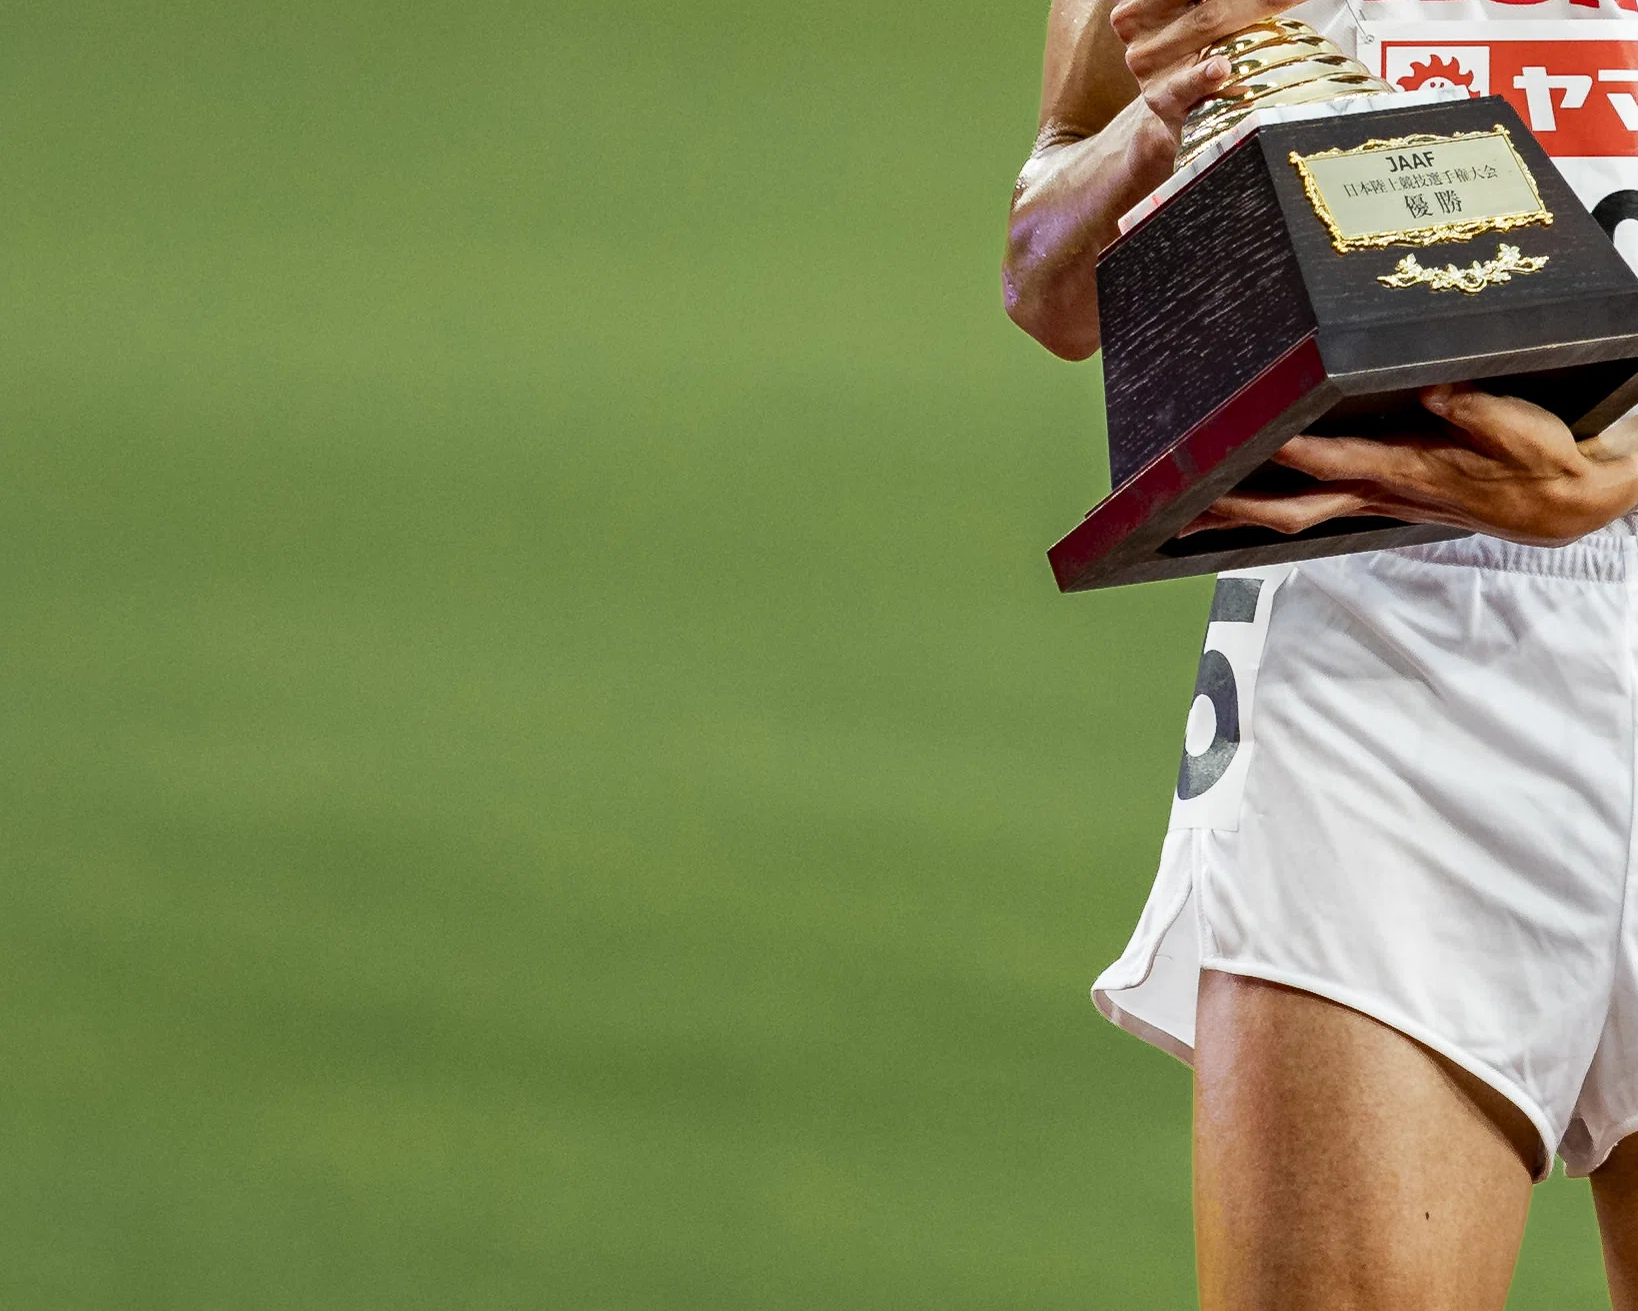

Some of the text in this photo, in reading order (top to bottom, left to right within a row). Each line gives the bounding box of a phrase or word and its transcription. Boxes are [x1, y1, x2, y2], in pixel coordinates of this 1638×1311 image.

[1385, 151, 1436, 173] JAAF
[1343, 164, 1498, 197] 日本陸上競技選手権大会
[1404, 190, 1463, 219] 優勝
